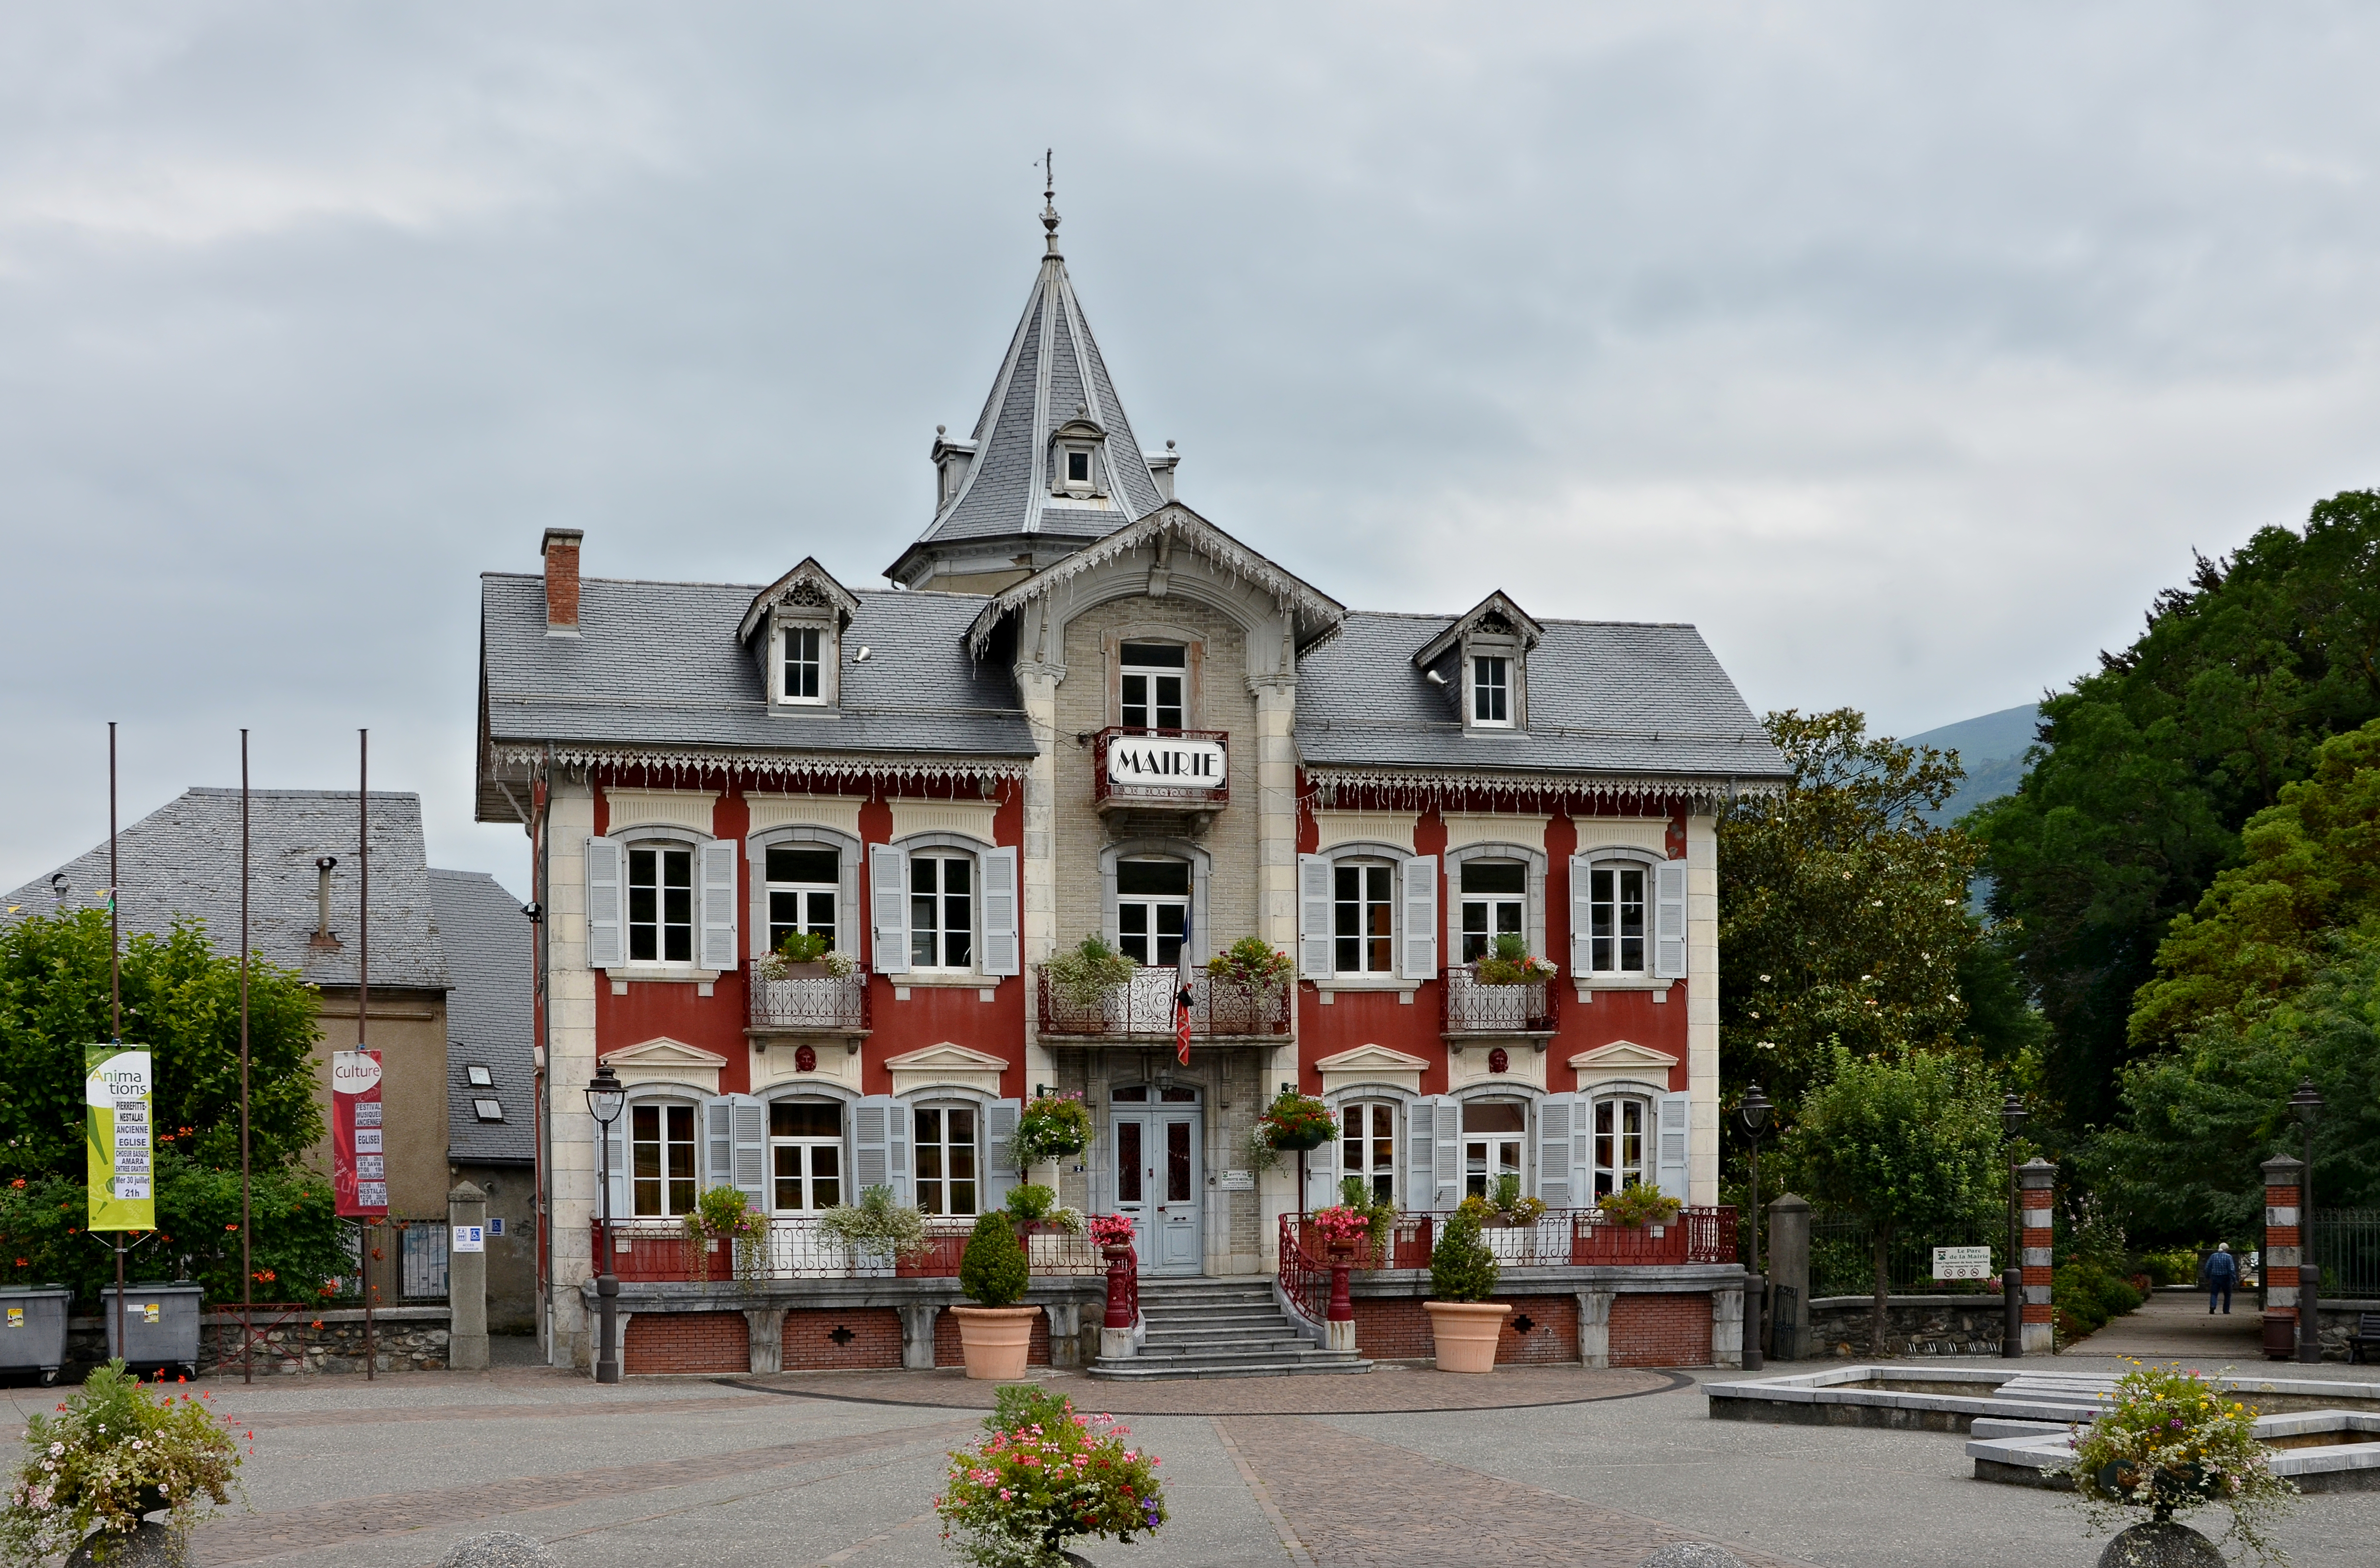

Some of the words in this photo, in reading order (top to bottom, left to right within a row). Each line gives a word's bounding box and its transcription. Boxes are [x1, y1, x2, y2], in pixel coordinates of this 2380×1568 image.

[1116, 749, 1218, 777] MAIRIE
[91, 1070, 141, 1082] Anima
[336, 1065, 380, 1078] Culture
[109, 1082, 146, 1095] tions
[116, 1102, 146, 1110] PIERREFITTE-
[120, 1113, 143, 1121] NESTALAS
[358, 1135, 380, 1144] EGLISES
[134, 1176, 150, 1186] juillet
[125, 1189, 139, 1197] 21h
